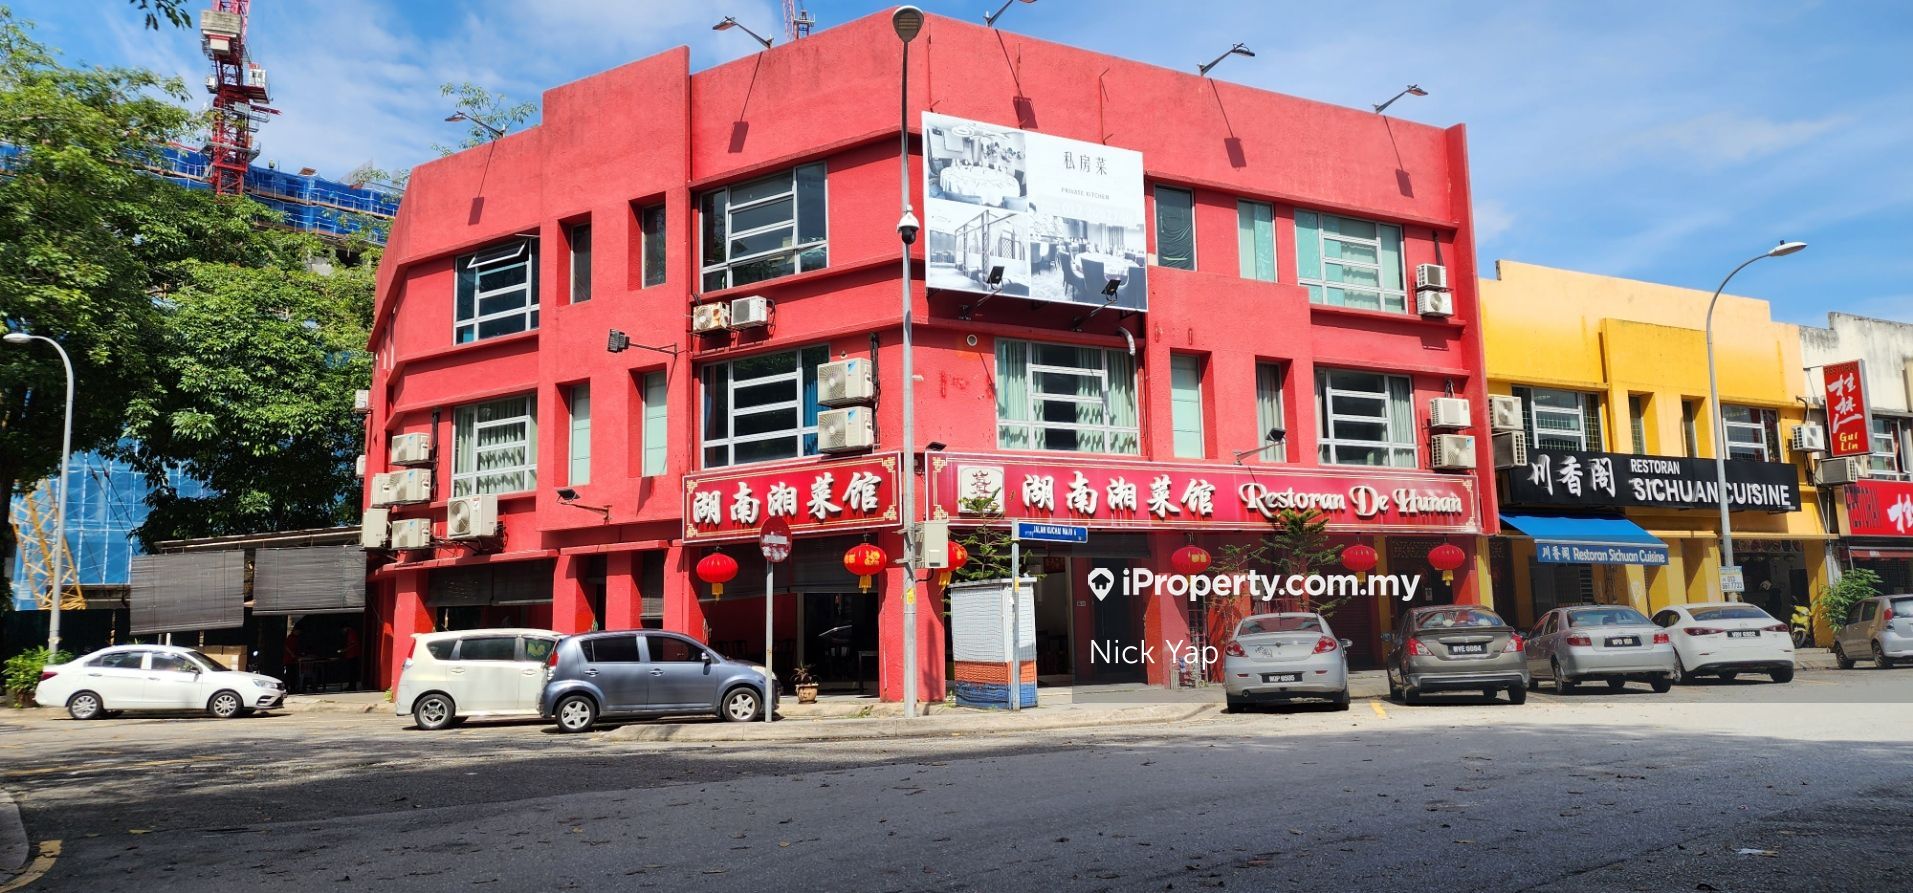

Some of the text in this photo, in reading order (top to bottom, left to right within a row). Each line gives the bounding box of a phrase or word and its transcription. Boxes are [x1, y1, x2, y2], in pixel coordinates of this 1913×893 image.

[1064, 151, 1107, 175] 私房菜
[1086, 192, 1110, 200] KITCHEN
[1631, 459, 1680, 474] RESTORAN
[693, 472, 881, 524] 湖南湘菜馆
[1022, 471, 1215, 517] 湖南湘菜馆
[1238, 483, 1462, 518] Restoran De Hunan
[1633, 478, 1791, 505] SICHUAN CUISINE
[1573, 548, 1665, 563] Restoran Sichuan Cuisine
